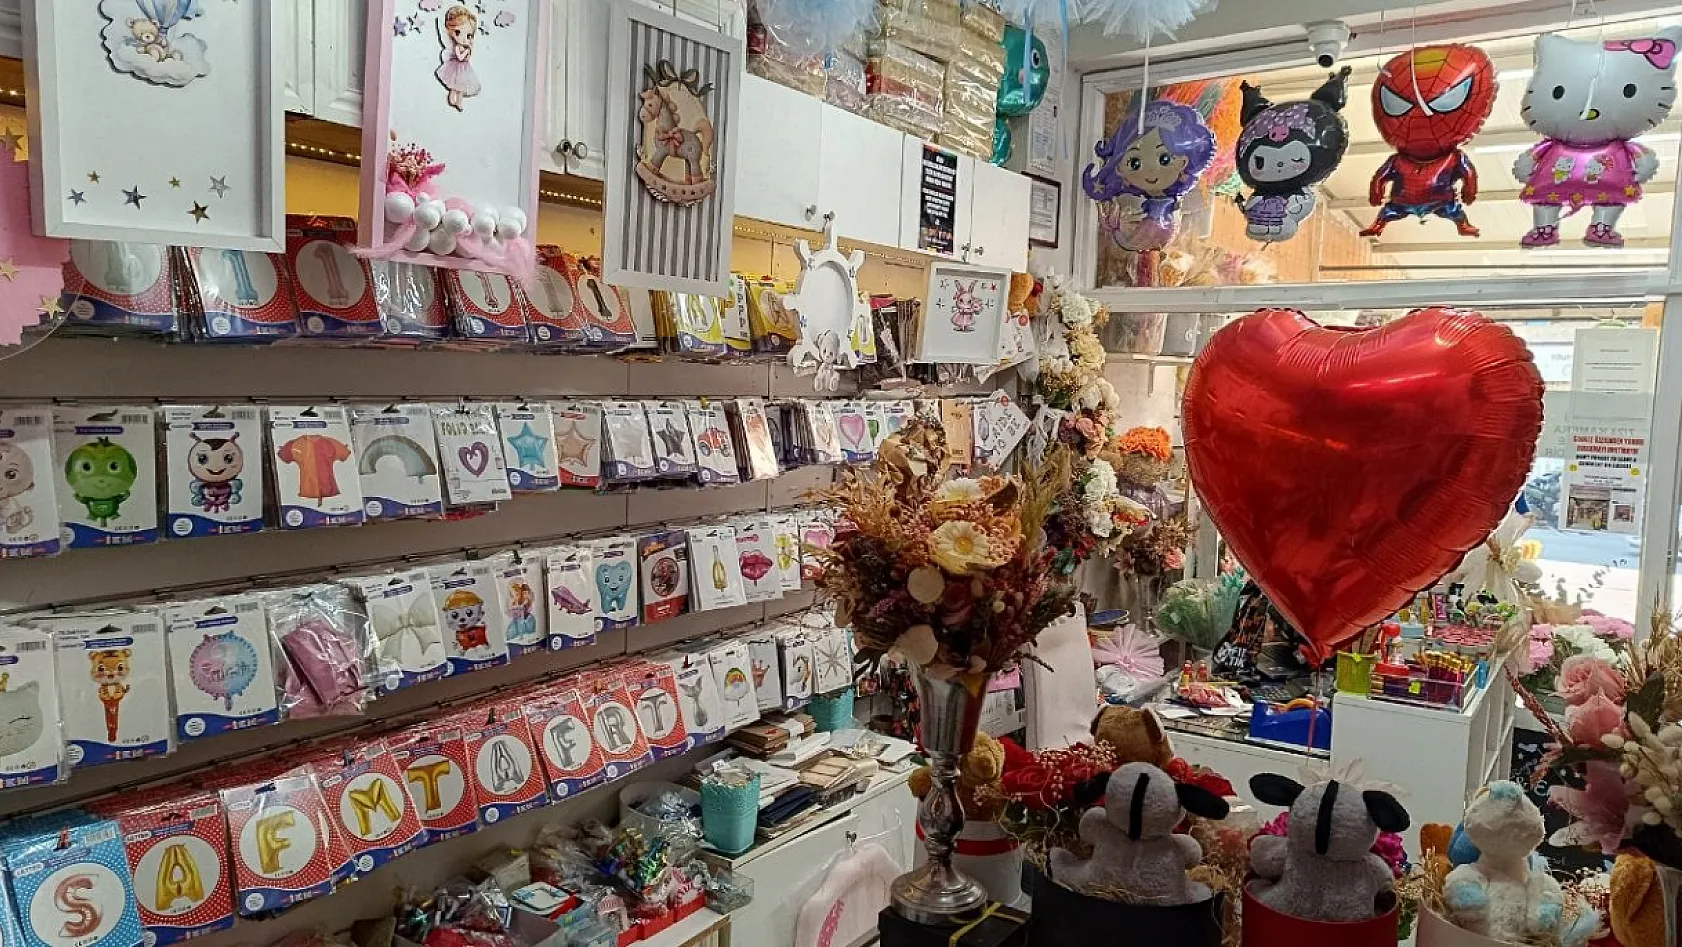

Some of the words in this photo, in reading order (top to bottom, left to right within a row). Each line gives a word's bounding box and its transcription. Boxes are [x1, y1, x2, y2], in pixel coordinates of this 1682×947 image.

[596, 706, 628, 752] R
[640, 692, 668, 733] T
[490, 739, 525, 792] A
[549, 717, 577, 769] F
[349, 778, 402, 836] M
[407, 760, 450, 810] T
[256, 810, 296, 874] F
[156, 844, 204, 911] A
[54, 874, 103, 937] S
